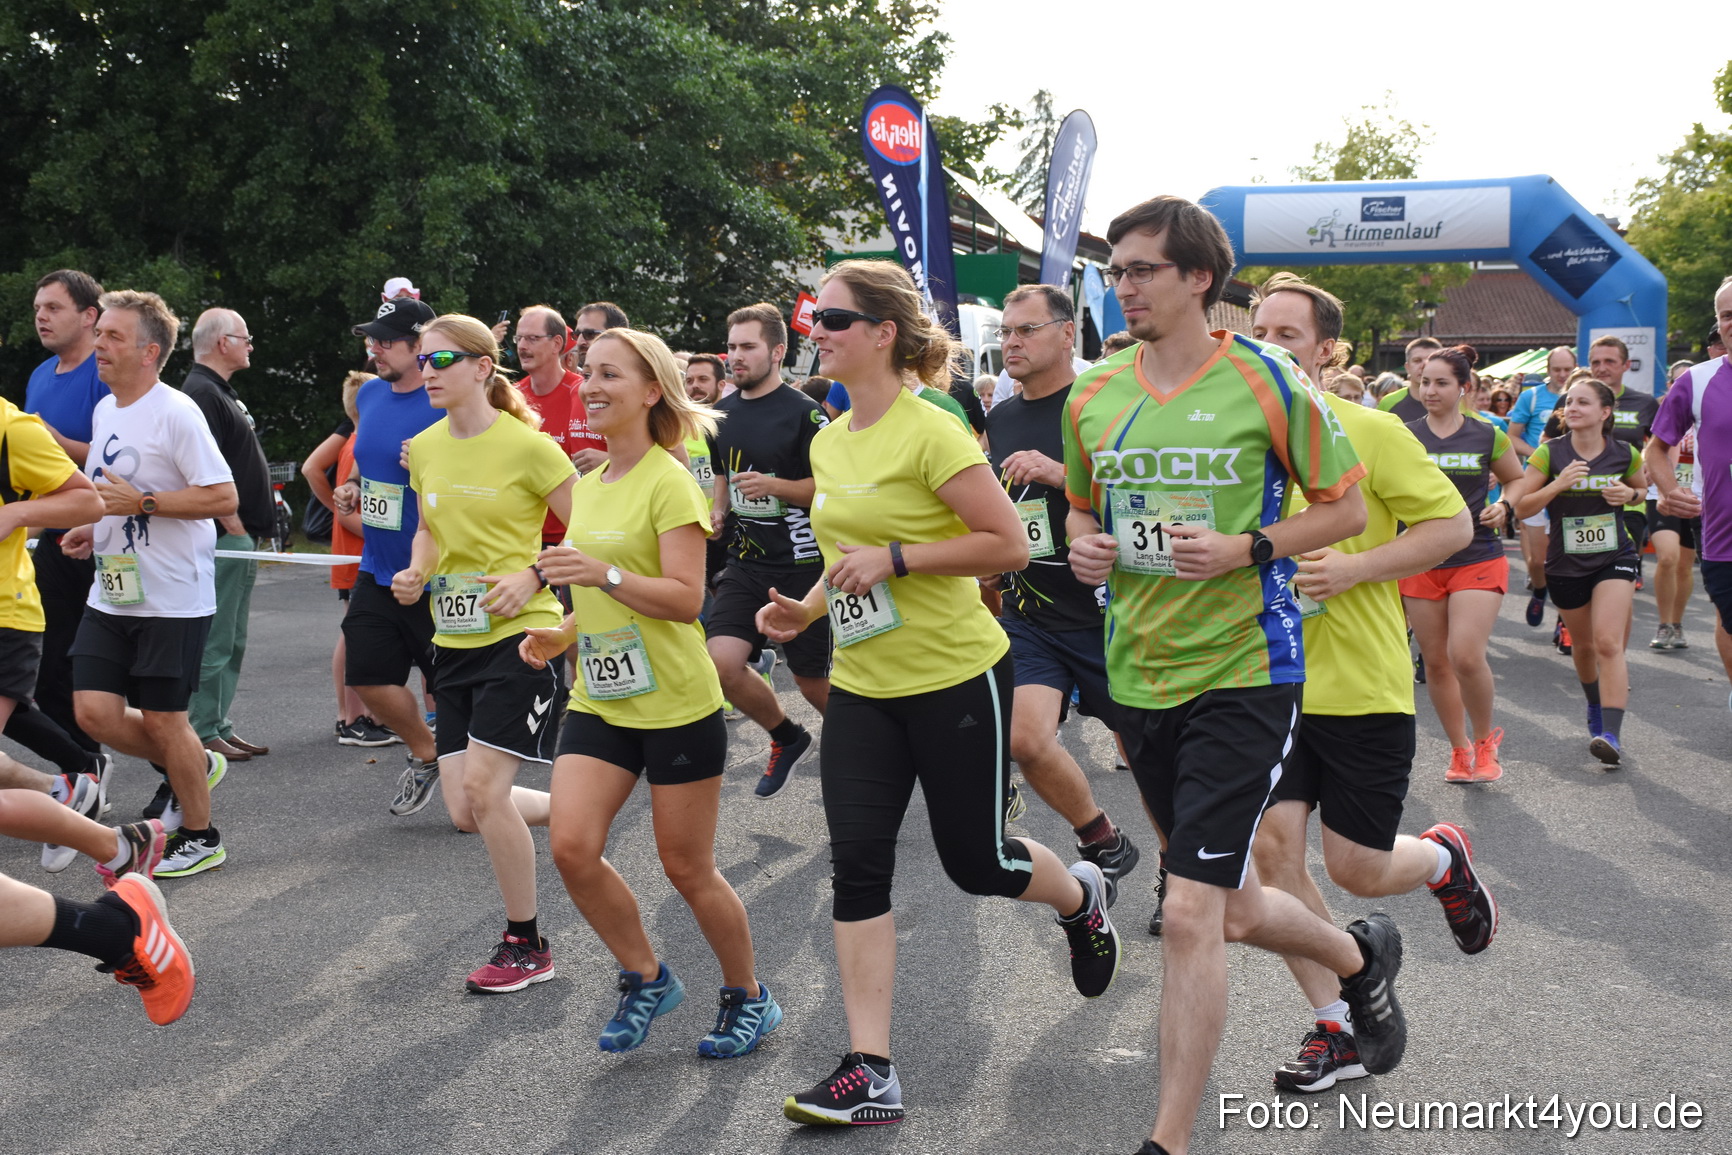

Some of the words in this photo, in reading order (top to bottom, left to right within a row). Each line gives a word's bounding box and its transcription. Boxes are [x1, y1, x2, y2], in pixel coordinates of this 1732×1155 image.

[1364, 201, 1403, 214] Fischer
[1344, 221, 1443, 241] firmenlauf
[586, 432, 602, 440] FRISCH
[1092, 448, 1242, 485] BOCK
[363, 495, 387, 515] 850
[1186, 513, 1207, 521] 2019
[1027, 521, 1042, 542] 6
[1131, 520, 1189, 552] 31
[1575, 528, 1606, 544] 300
[1136, 552, 1154, 562] Lang
[1155, 552, 1175, 562] Step
[437, 594, 478, 618] 1267
[829, 590, 878, 627] 1281
[855, 619, 868, 629] Inga
[586, 652, 636, 682] 1291
[613, 678, 636, 688] Nadine
